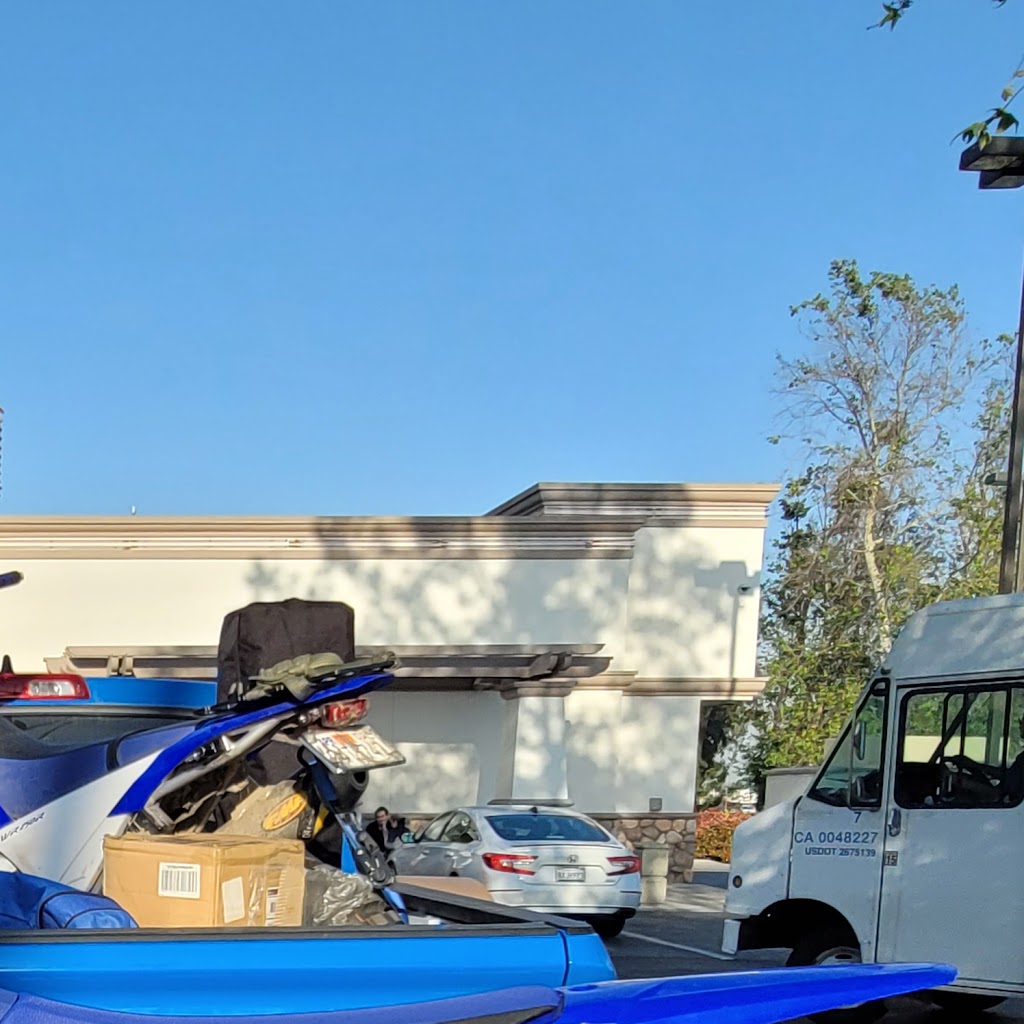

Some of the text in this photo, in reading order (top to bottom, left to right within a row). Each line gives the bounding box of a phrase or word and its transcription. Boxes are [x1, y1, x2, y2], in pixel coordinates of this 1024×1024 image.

[854, 811, 862, 823] 7
[794, 831, 878, 844] CA 0048227
[805, 847, 837, 856] USDOT
